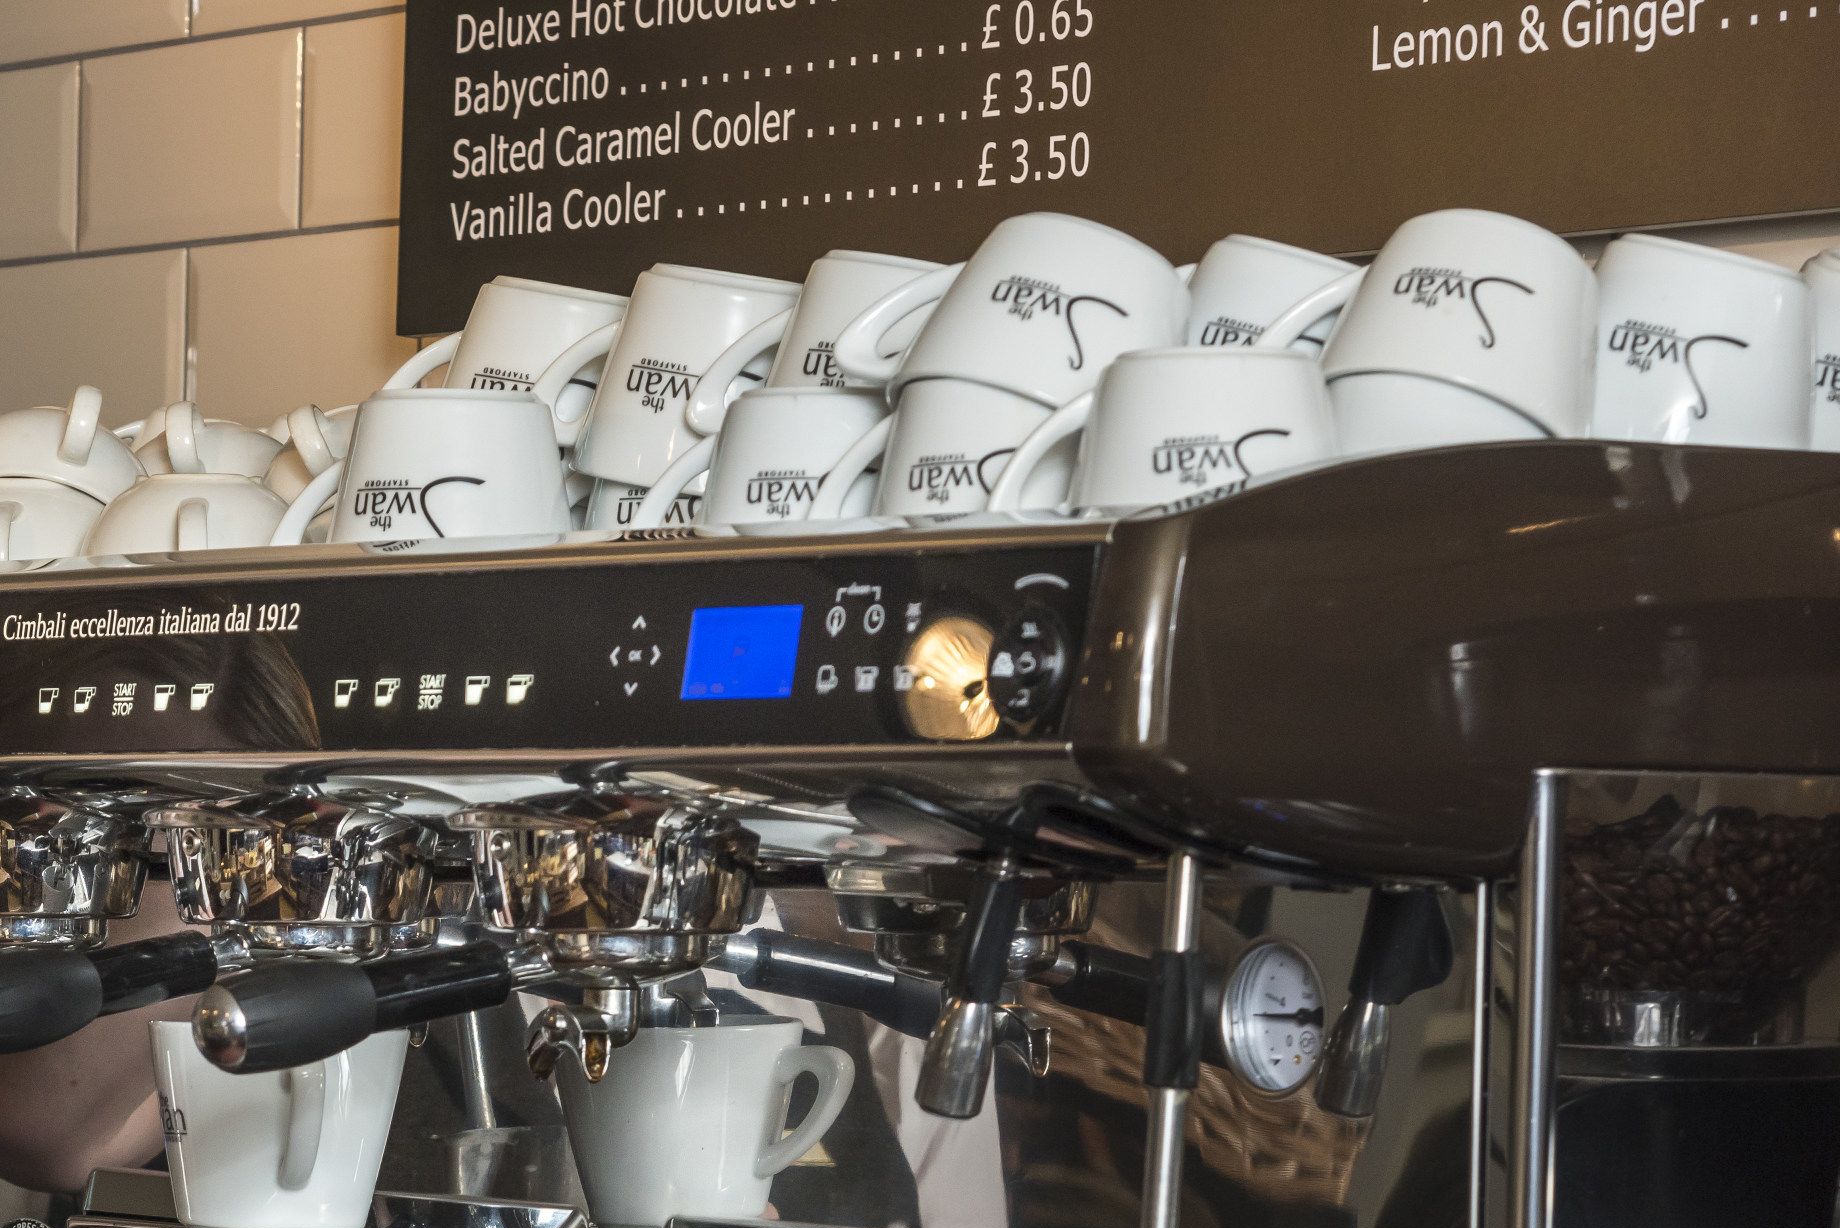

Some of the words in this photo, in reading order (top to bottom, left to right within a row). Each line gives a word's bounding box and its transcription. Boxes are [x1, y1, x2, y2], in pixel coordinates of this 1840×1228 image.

[456, 7, 559, 53] Deluxe
[571, 0, 625, 37] Hot
[1372, 20, 1503, 71] Lemon
[1518, 4, 1549, 53] &
[1562, 0, 1704, 52] Ginger
[454, 62, 609, 118] Babyccino
[452, 128, 546, 179] Salted
[556, 110, 680, 167] Caramel
[692, 101, 795, 150] Cooler
[450, 192, 553, 240] Vanilla
[563, 181, 666, 230] Cooler
[483, 367, 530, 380] STAFFORD
[641, 358, 688, 372] STAFFORD
[642, 395, 665, 413] the
[365, 479, 409, 487] STAFFORD
[370, 515, 392, 532] the
[3, 612, 66, 640] Cimbali
[70, 609, 154, 638] eccellenza
[158, 607, 220, 634] italiana
[224, 603, 251, 632] dal
[256, 602, 301, 631] 1912
[114, 683, 137, 696] START
[419, 674, 447, 689] START
[112, 702, 133, 716] STOP
[417, 695, 442, 710] STOP
